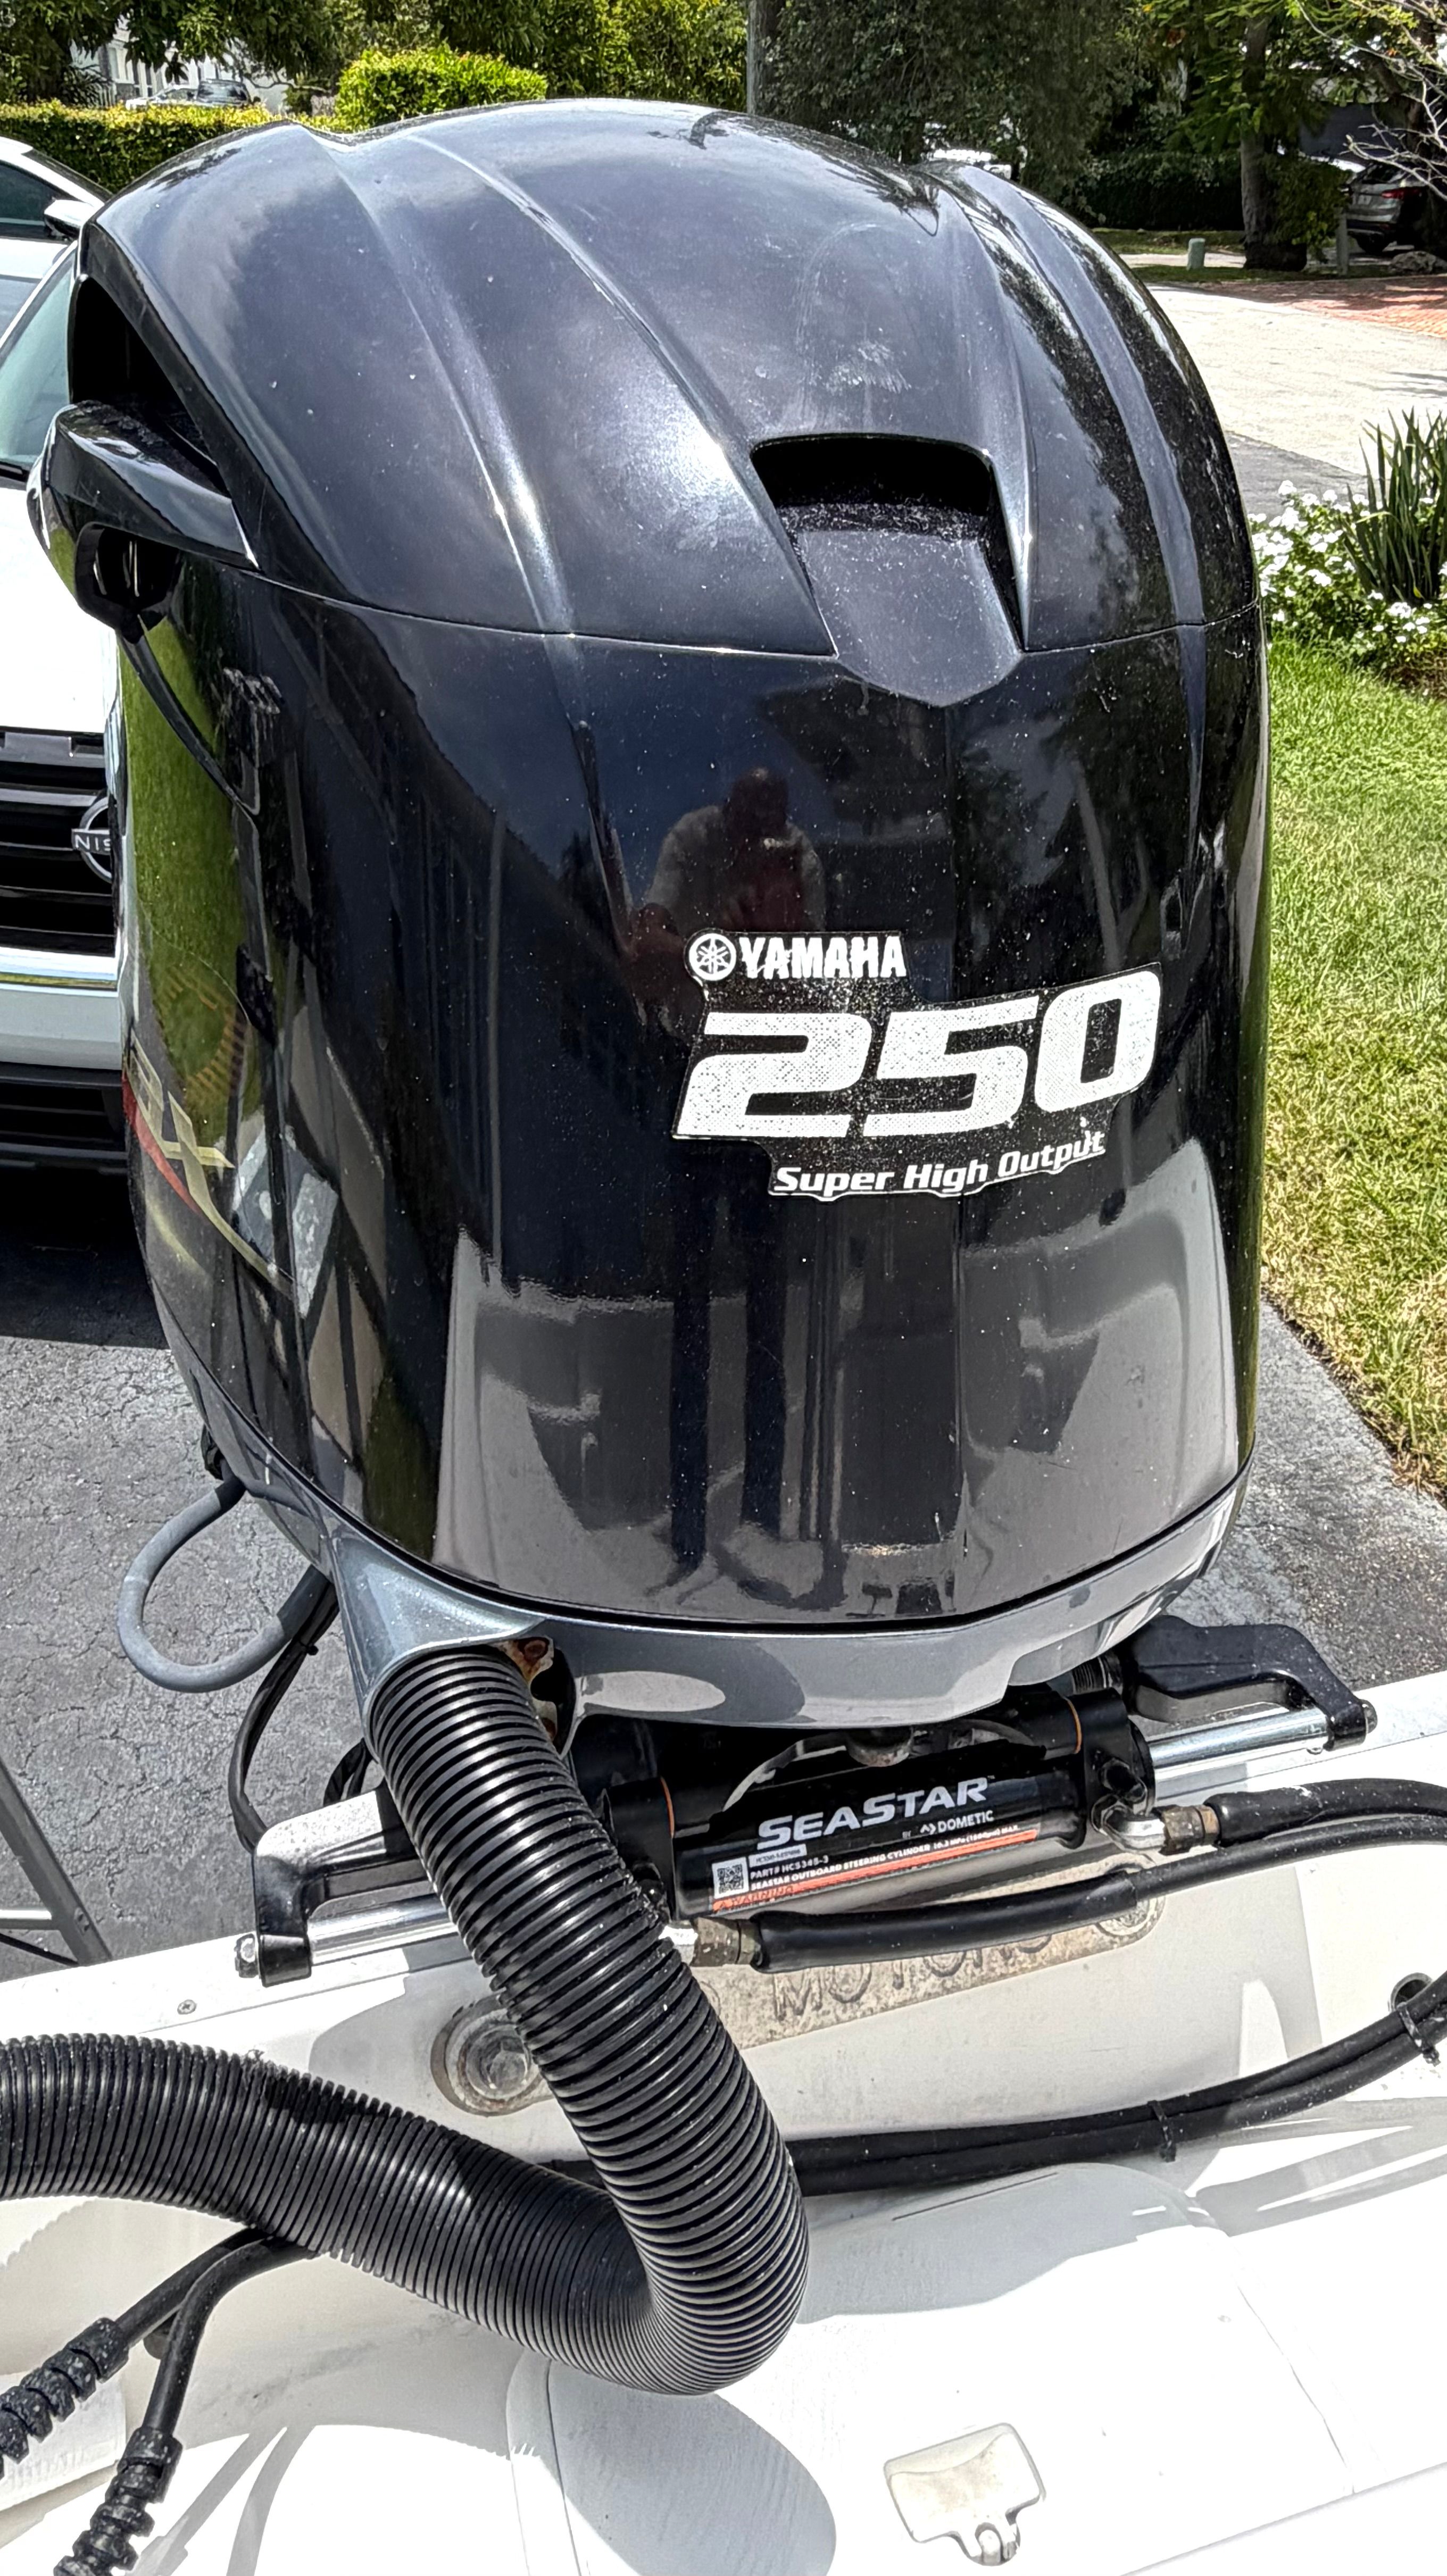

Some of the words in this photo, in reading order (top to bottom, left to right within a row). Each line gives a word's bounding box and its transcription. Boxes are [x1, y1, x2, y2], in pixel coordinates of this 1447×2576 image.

[739, 936, 906, 979] YAMAHA
[676, 971, 1161, 1138] 250
[774, 1167, 895, 1196] Super
[903, 1160, 988, 1193] High
[998, 1130, 1105, 1177] Output
[756, 1777, 988, 1850] SEASTAR
[937, 1810, 994, 1833] DOMETIC
[750, 1865, 780, 1880] PART#
[751, 1875, 791, 1891] SEASTAR
[792, 1863, 842, 1881] OUTBOARD
[844, 1854, 886, 1870] STEERING
[887, 1844, 931, 1860] CYLINDER
